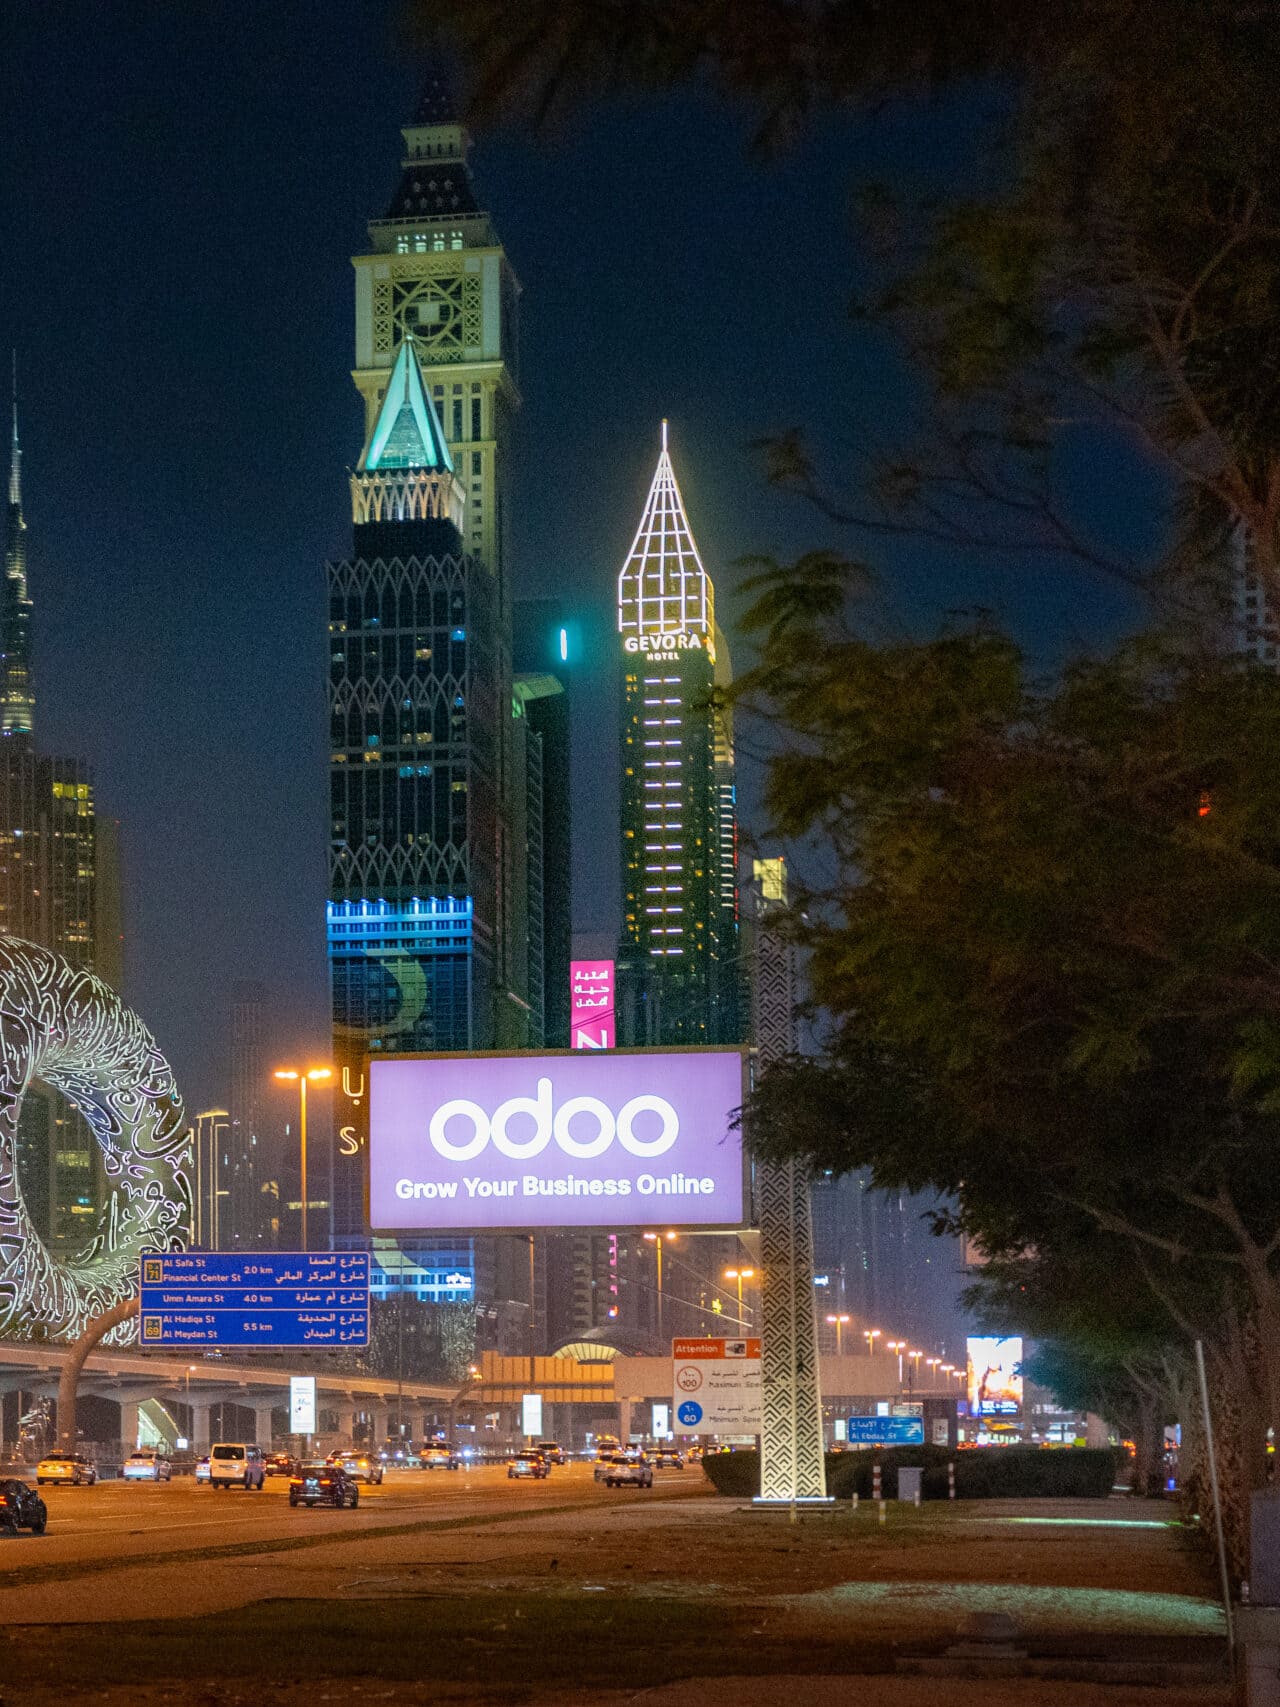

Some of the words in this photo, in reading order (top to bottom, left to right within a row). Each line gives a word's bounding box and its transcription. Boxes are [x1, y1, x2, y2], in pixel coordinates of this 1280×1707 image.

[624, 634, 701, 652] GEVORA
[646, 652, 679, 661] HOTEL
[429, 1077, 680, 1161] odoo
[395, 1177, 458, 1201] Grow
[463, 1177, 518, 1199] Your
[523, 1175, 632, 1197] Business
[637, 1173, 715, 1196] Online
[163, 1259, 173, 1267] Al
[175, 1259, 194, 1267] Safa
[195, 1259, 206, 1267] St
[308, 1256, 336, 1266] الصفا
[339, 1256, 366, 1268] شارع
[243, 1266, 258, 1274] 2.0
[259, 1266, 273, 1274] km
[163, 1274, 198, 1282] Financial
[200, 1274, 228, 1282] Center
[231, 1274, 242, 1282] St
[275, 1271, 303, 1284] المالي
[307, 1271, 336, 1282] المركز
[339, 1271, 366, 1283] شارع
[162, 1294, 184, 1303] Umm
[185, 1294, 213, 1303] Amara
[214, 1294, 224, 1303] St
[243, 1294, 258, 1303] 4.0
[259, 1294, 273, 1303] km
[339, 1292, 365, 1304] شارع
[163, 1315, 173, 1324] Al
[174, 1315, 204, 1325] Hadiqa
[205, 1315, 216, 1324] St
[339, 1313, 366, 1325] شارع
[146, 1327, 160, 1336] 69
[243, 1322, 258, 1331] 5.5
[258, 1322, 273, 1331] km
[163, 1330, 173, 1338] Al
[174, 1330, 206, 1340] Meydan
[207, 1330, 218, 1338] St
[303, 1328, 336, 1339] الميدان
[339, 1328, 366, 1340] شارع
[675, 1345, 718, 1353] Attention
[682, 1379, 697, 1388] 100
[908, 1406, 922, 1415] 52
[683, 1415, 697, 1423] 60
